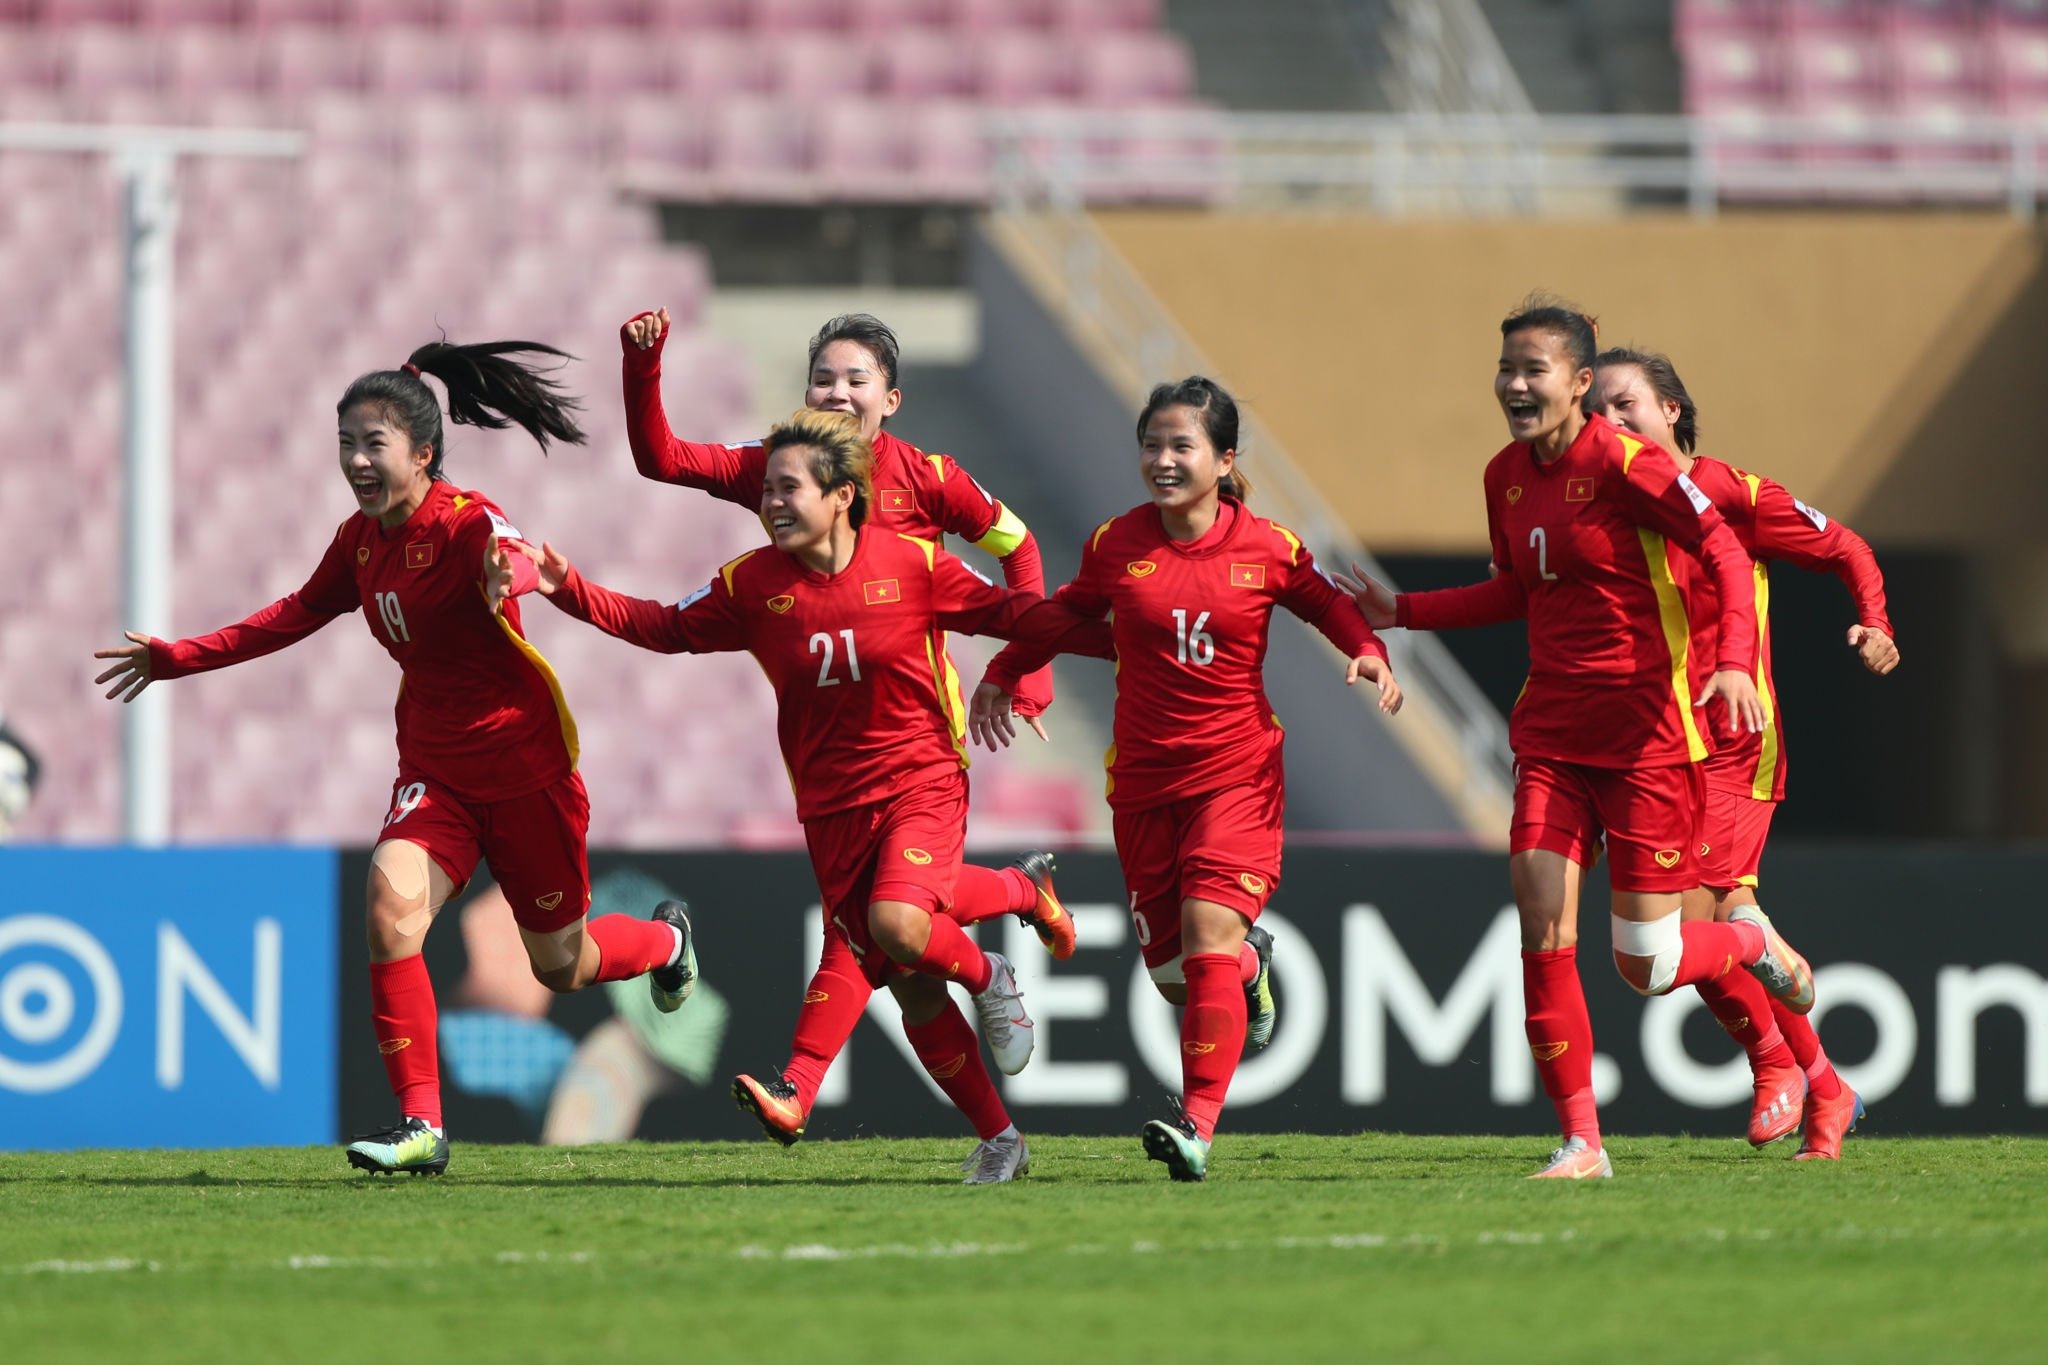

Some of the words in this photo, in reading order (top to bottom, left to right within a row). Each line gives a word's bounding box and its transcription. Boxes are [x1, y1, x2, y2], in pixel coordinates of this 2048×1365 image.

[1529, 526, 1558, 580] 2
[375, 591, 410, 643] 19
[1172, 608, 1215, 666] 16
[809, 628, 862, 688] 21
